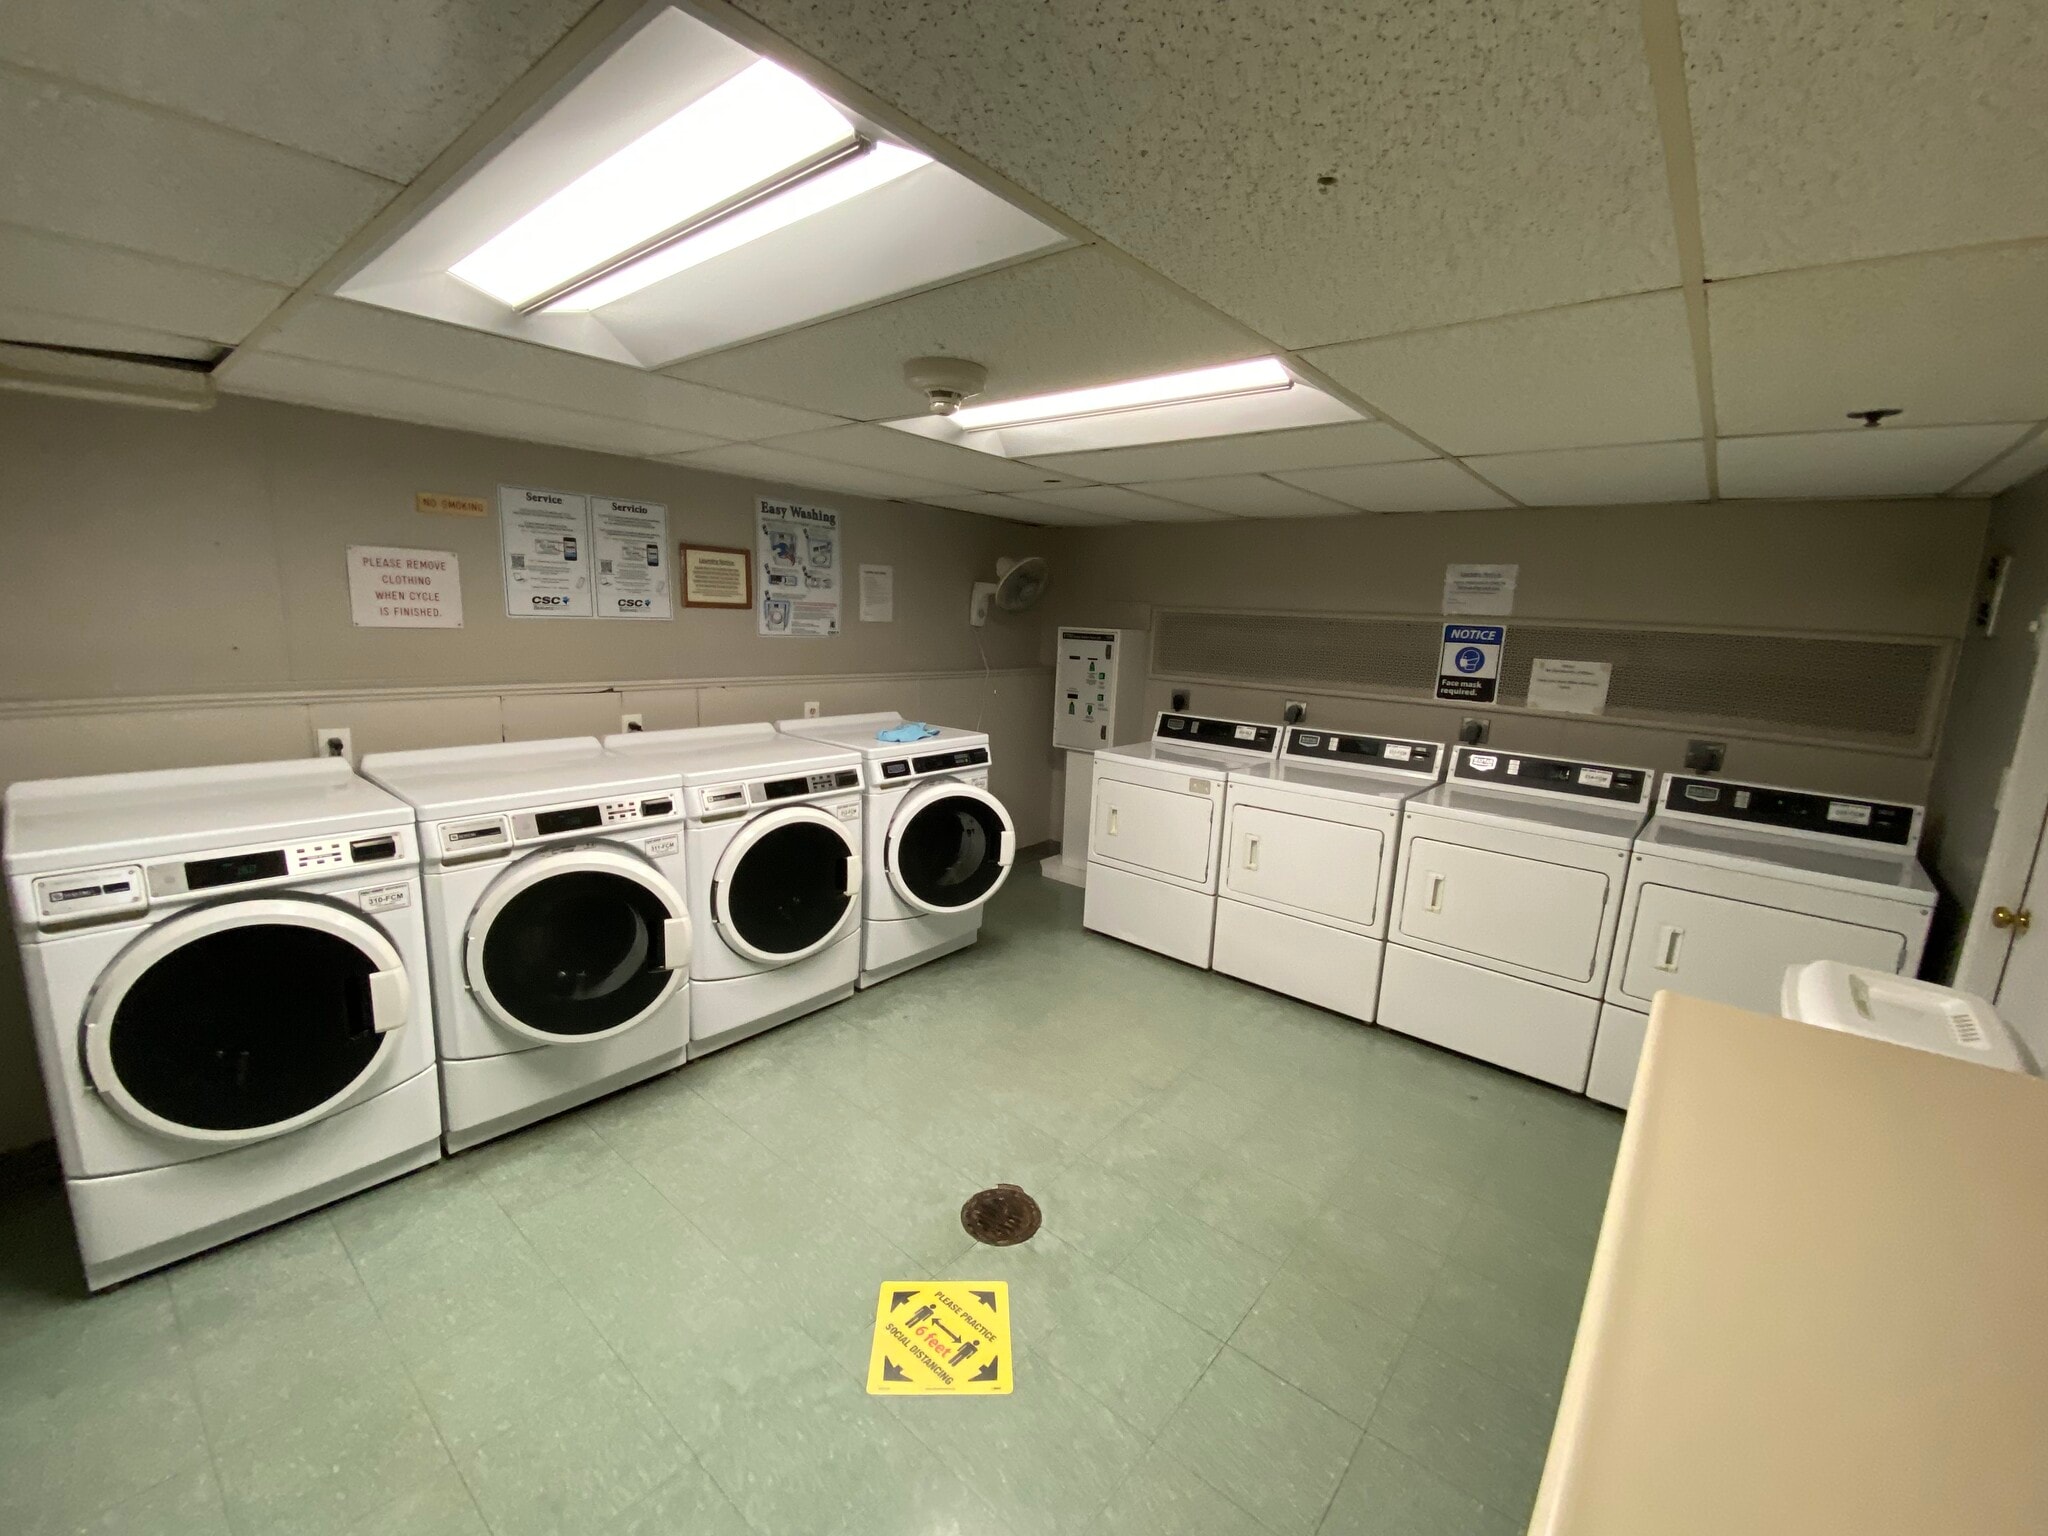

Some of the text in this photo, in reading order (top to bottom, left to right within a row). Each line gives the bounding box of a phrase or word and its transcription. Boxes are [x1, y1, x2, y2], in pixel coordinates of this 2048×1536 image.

[526, 491, 563, 504] Service
[423, 498, 485, 512] NO SMOKING
[611, 502, 648, 514] Servicio
[761, 501, 836, 526] Easy Washing
[362, 557, 446, 571] PLEASE REMOVE
[381, 575, 431, 585] CLOTHING
[375, 591, 440, 601] WHEN CYCLE
[531, 596, 561, 605] CSC
[618, 599, 644, 607] CSC
[380, 607, 442, 617] IS FINISHED.
[1451, 629, 1497, 641] NOTICE
[1441, 679, 1482, 689] Face mask
[1440, 687, 1478, 697] required.
[369, 893, 404, 905] 310-FCM
[934, 1291, 997, 1343] PLEASE PRACTICE
[915, 1326, 952, 1358] 6 feet
[885, 1323, 955, 1385] SOCIAL DISTANCING
